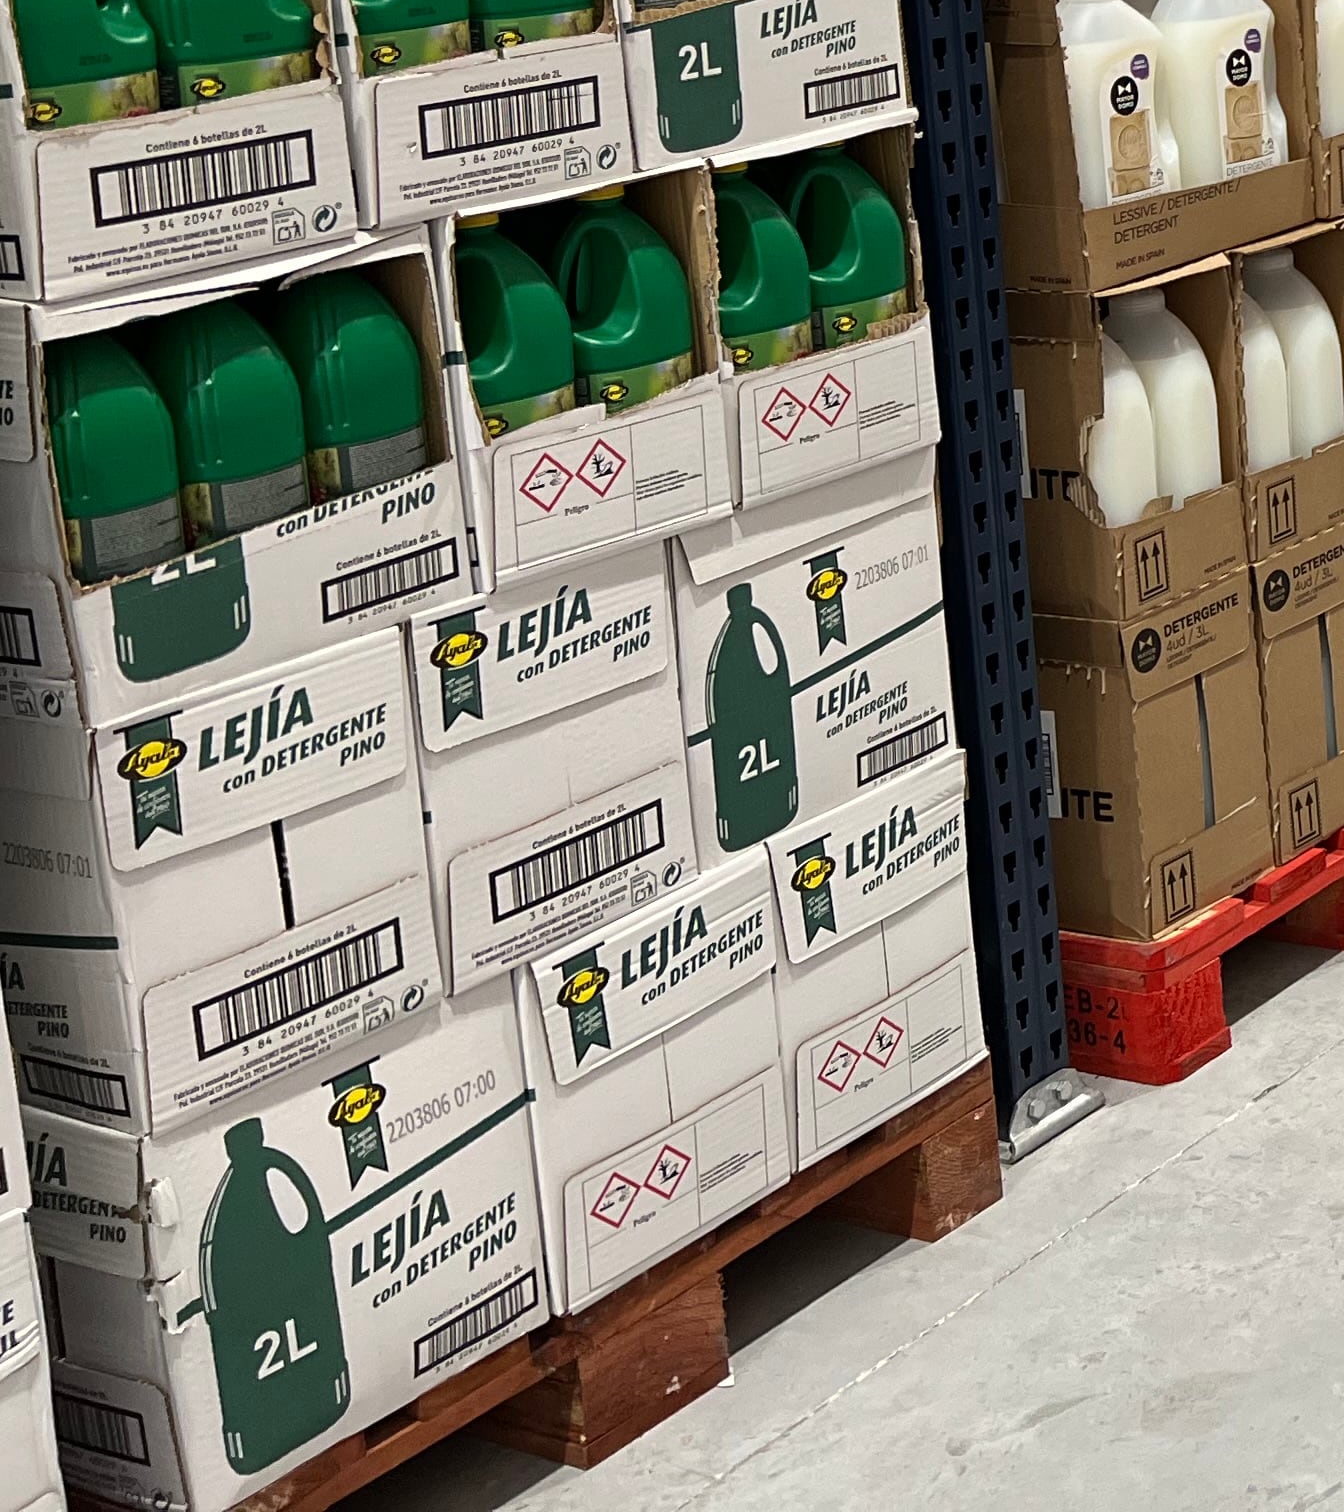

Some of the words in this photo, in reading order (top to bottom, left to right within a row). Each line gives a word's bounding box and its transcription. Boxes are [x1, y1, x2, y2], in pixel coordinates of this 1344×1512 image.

[678, 42, 722, 81] 2L
[771, 46, 788, 58] con
[790, 20, 856, 53] DETERGENTE
[826, 36, 856, 58] PINO
[146, 140, 190, 154] Contiene
[193, 136, 198, 145] 6
[200, 130, 240, 145] botellas
[242, 127, 254, 138] de
[256, 124, 267, 134] 2L
[1113, 202, 1157, 225] LESSIVE
[1168, 181, 1235, 211] DETERGENTE
[1114, 215, 1179, 244] DETERGENT
[854, 560, 900, 591] 2203806
[901, 543, 930, 572] 07:01
[497, 585, 593, 663] LEJÍA
[549, 605, 652, 669] DETERGENTE
[1164, 592, 1239, 638] DETERGENTE
[613, 631, 651, 663] PINO
[198, 683, 314, 771] LEJÍA
[262, 703, 387, 779] DETERGENTE
[339, 731, 386, 767] PINO
[738, 738, 780, 783] 2L
[621, 904, 708, 990] LEJÍA
[670, 909, 764, 989] DETERGENTE
[729, 934, 764, 970] PINO
[386, 1093, 451, 1144] 2203806
[454, 1069, 497, 1108] 07:00
[351, 1189, 451, 1288] LEJÍA
[406, 1191, 516, 1287] DETERGENTE
[468, 1219, 518, 1273] PINO
[254, 1318, 318, 1381] 2L
